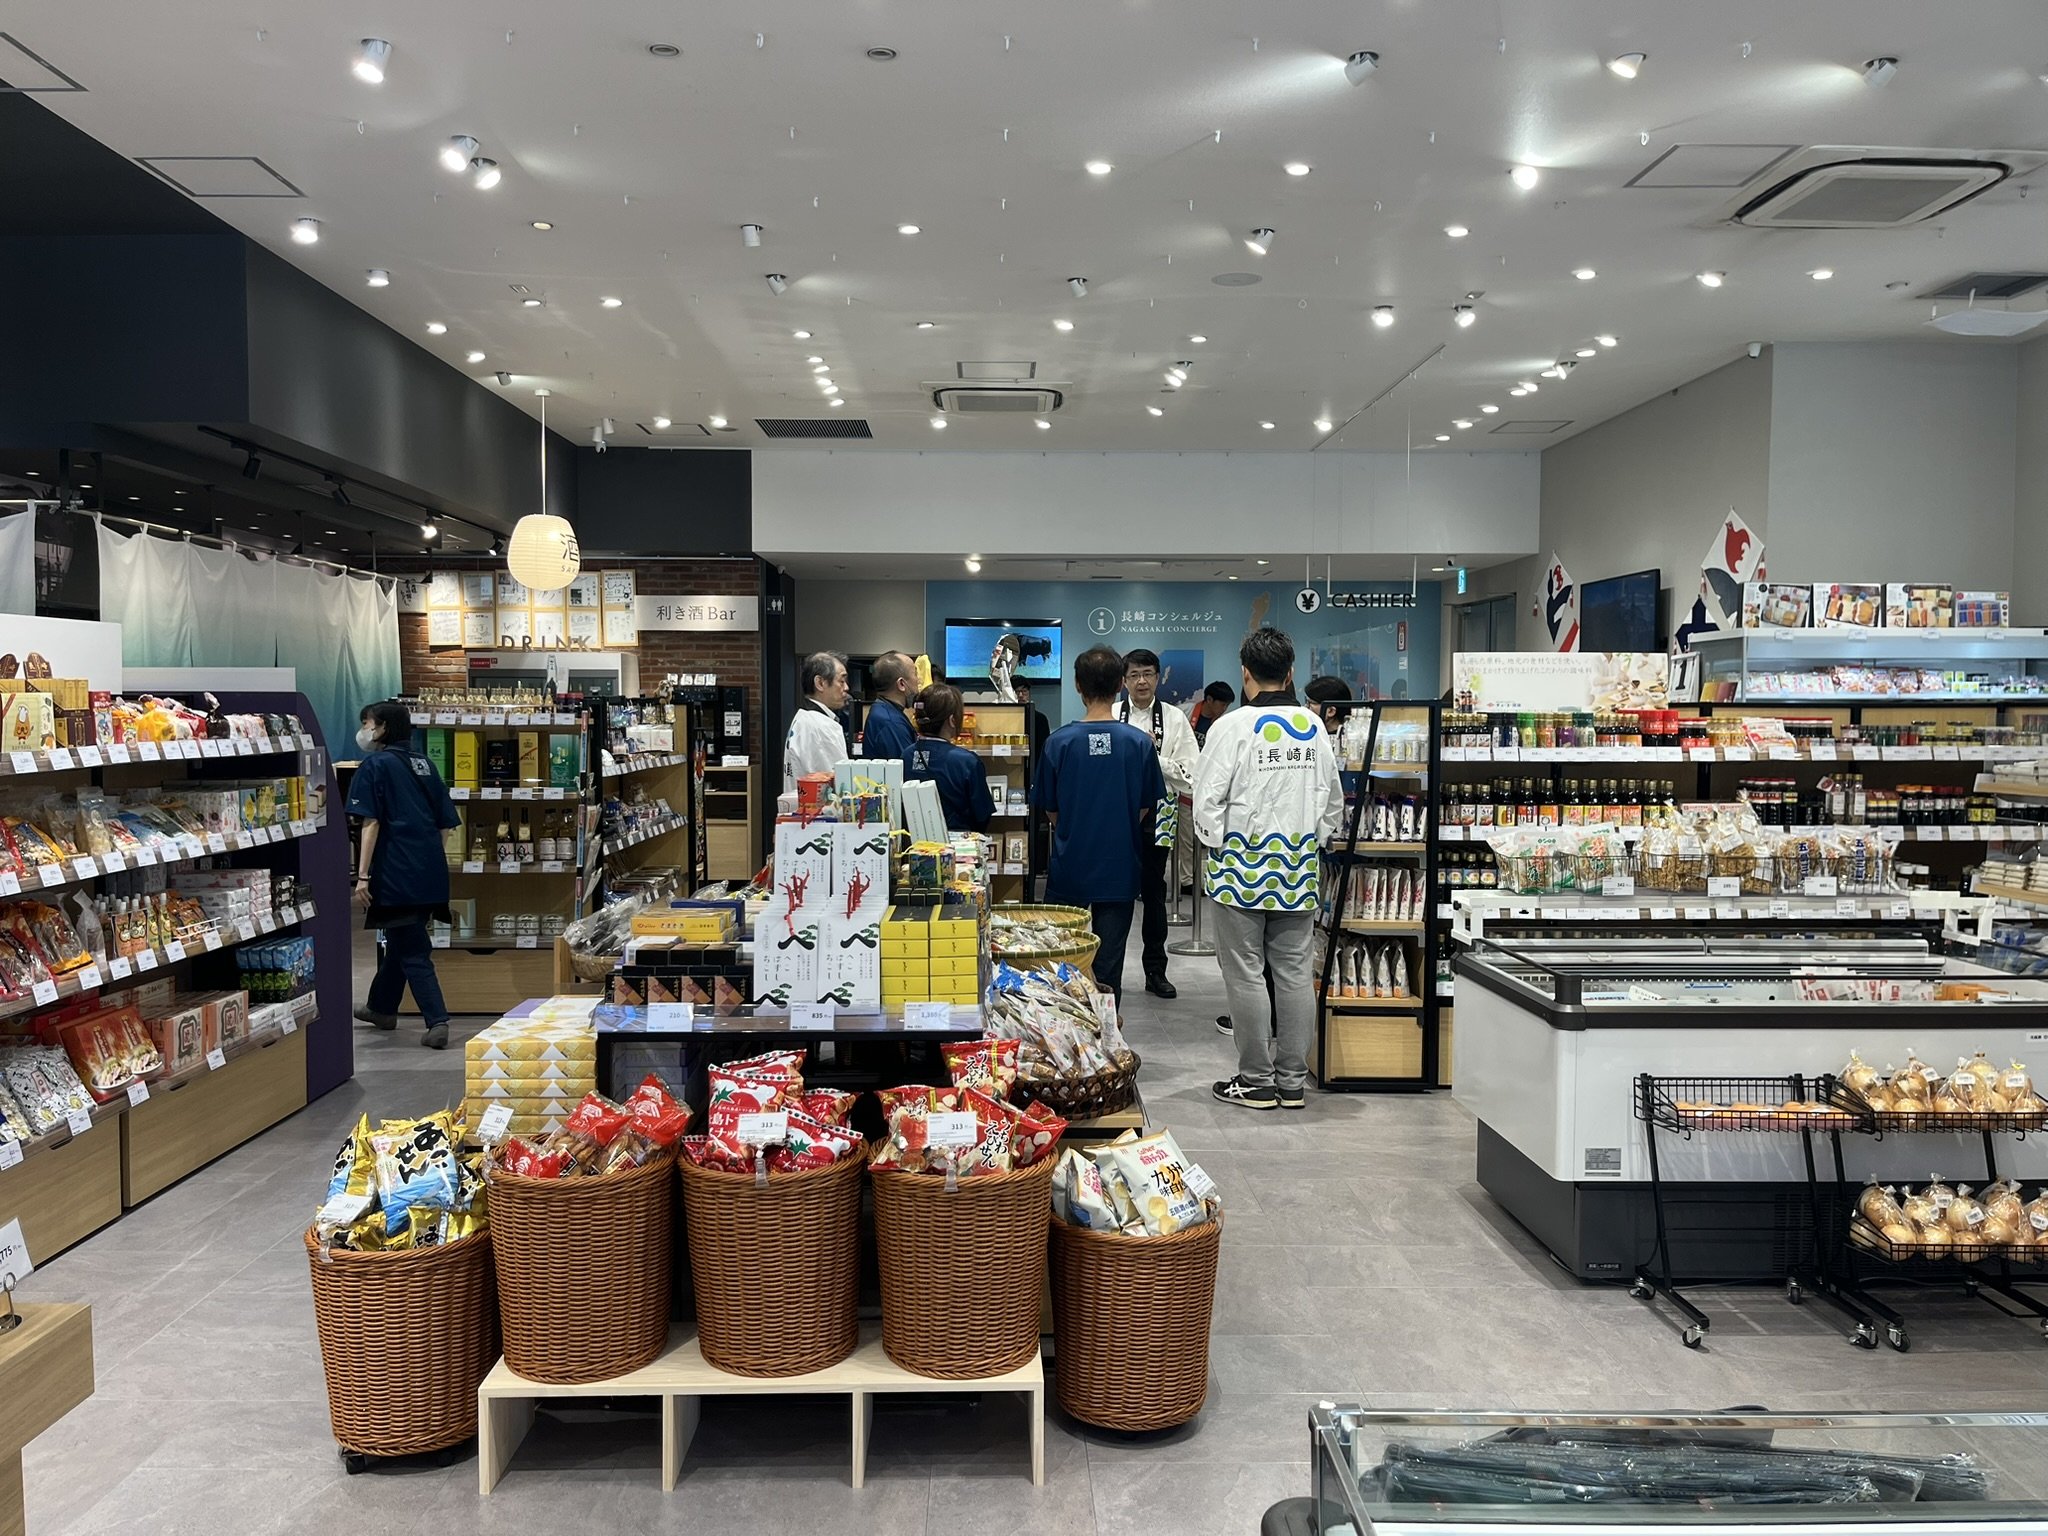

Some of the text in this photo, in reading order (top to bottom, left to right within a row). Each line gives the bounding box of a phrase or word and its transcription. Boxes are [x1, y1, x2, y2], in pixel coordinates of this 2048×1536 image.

[1331, 593, 1413, 608] CASHIER
[656, 605, 737, 621] 利き酒 Bar
[1121, 611, 1223, 622] 長崎コンシェルジュ
[1121, 625, 1218, 633] NAGASAKI CONCIERGE
[501, 635, 592, 652] DRINK
[1267, 747, 1316, 763] 長崎館
[979, 1120, 1000, 1169] えびせん
[995, 1119, 1014, 1155] うちわ
[1151, 1161, 1185, 1188] 九州
